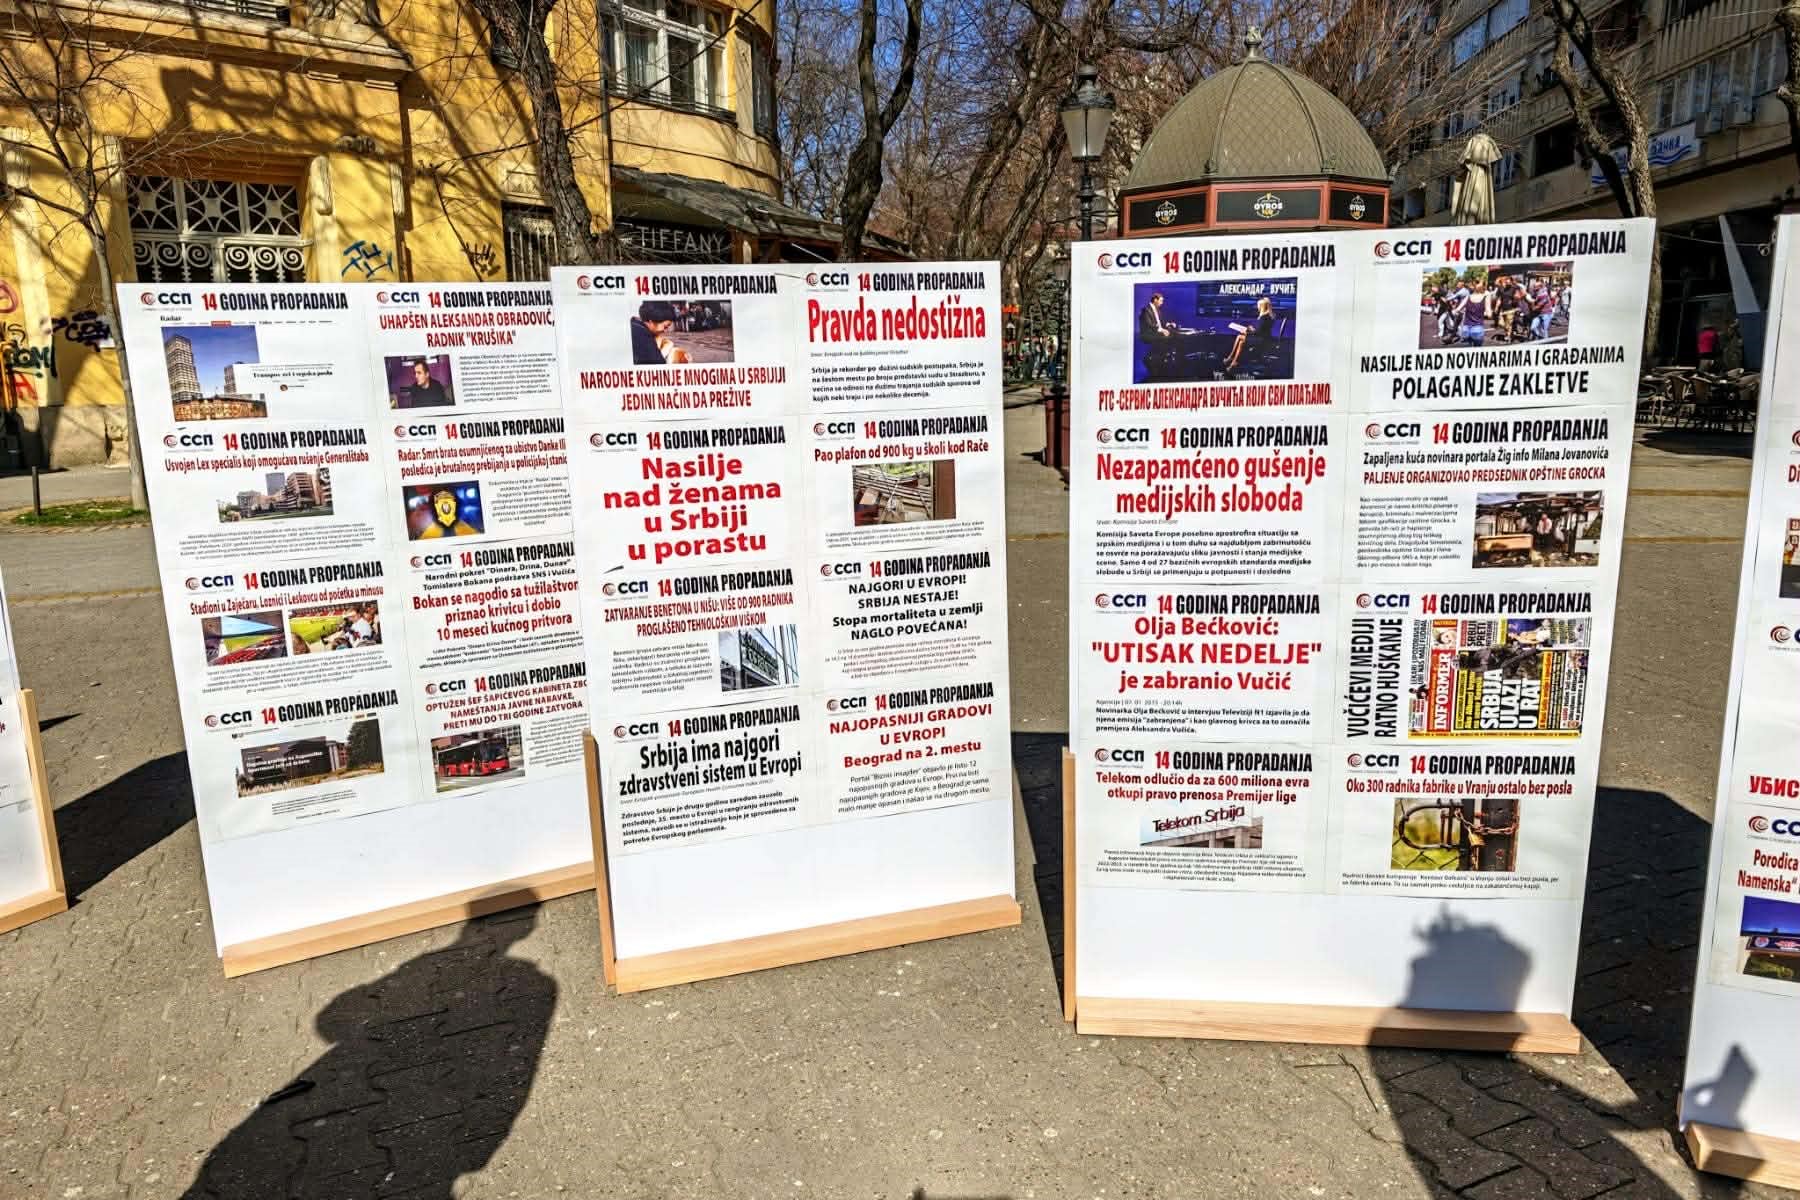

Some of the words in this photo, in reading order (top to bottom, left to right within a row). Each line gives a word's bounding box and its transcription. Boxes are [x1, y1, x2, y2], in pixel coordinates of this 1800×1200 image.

[636, 225, 725, 253] TIFFANY
[1164, 251, 1179, 273] 14
[1183, 249, 1237, 272] GODINA
[1242, 245, 1334, 269] PROPADANJA
[202, 293, 217, 310] 14
[220, 293, 268, 310] GODINA
[271, 292, 347, 309] PROPADANJA
[430, 312, 494, 327] ALEKSANDAR
[807, 296, 877, 342] Pravda
[426, 332, 465, 347] RADNIK
[1361, 354, 1411, 372] NASILJE
[1415, 353, 1443, 370] NAD
[1446, 350, 1531, 368] NOVINARIMA
[1535, 349, 1539, 365] I
[580, 371, 634, 388] NARODNE
[636, 369, 681, 386] KUHINJE
[684, 368, 735, 385] MNOGIMA
[738, 367, 745, 384] U
[1392, 374, 1495, 399] POLAGANJE
[1500, 371, 1589, 396] ZAKLETVE
[622, 393, 655, 410] JEDINI
[692, 391, 707, 408] DA
[1268, 385, 1285, 405] СВИ
[165, 458, 195, 473] Usvojen
[196, 458, 209, 470] Lex
[211, 455, 241, 471] specialis
[242, 455, 256, 470] koji
[815, 448, 833, 461] Pao
[835, 446, 866, 463] plafon
[868, 445, 880, 458] od
[882, 444, 900, 457] 900
[902, 443, 914, 459] kg
[916, 446, 921, 455] u
[947, 440, 965, 453] kod
[1364, 451, 1404, 467] Zapaljena
[1427, 450, 1463, 463] novinara
[1465, 449, 1495, 465] portala
[1512, 448, 1529, 461] info
[1531, 447, 1559, 460] Milana
[642, 453, 742, 481] Nasilje
[603, 484, 661, 509] nad
[1117, 484, 1215, 520] medijskih
[1221, 483, 1303, 512] sloboda
[644, 516, 662, 533] u
[671, 504, 747, 533] Srbiji
[628, 543, 646, 560] u
[654, 533, 766, 564] porastu
[849, 580, 903, 593] NAJGORI
[906, 579, 915, 588] U
[918, 574, 965, 587] EVROPI!
[858, 595, 900, 608] SRBIJA
[903, 590, 958, 604] NESTAJE!
[437, 627, 450, 640] 10
[452, 622, 488, 638] meseci
[531, 614, 572, 631] pritvora
[1135, 617, 1176, 639] Olja
[1182, 615, 1279, 635] Bećković:
[1351, 618, 1375, 666] MEDIJI
[1119, 670, 1138, 693] je
[1143, 671, 1233, 690] zabranio
[1435, 652, 1451, 729] INFORMER
[1480, 669, 1503, 729] SRBIJA
[1500, 679, 1521, 729] ULAZI
[1522, 679, 1540, 712] RAT
[830, 712, 924, 734] NAJOPASNIJI
[928, 704, 992, 721] GRADOVI
[1375, 695, 1397, 738] RATNO
[1520, 715, 1538, 729] U
[880, 735, 889, 745] U
[894, 727, 946, 744] EVROPI
[640, 744, 688, 771] Srbija
[692, 739, 721, 761] ima
[724, 728, 780, 762] najgori
[844, 749, 902, 768] Beograd
[906, 748, 922, 759] na
[926, 746, 938, 757] 2.
[941, 740, 982, 755] mestu
[620, 765, 700, 796] zdravstveni
[703, 763, 746, 785] sistem
[748, 763, 757, 776] u
[760, 751, 802, 777] Evropi
[1096, 771, 1141, 783] Telekom
[1187, 773, 1200, 784] da
[1203, 777, 1215, 785] za
[1218, 775, 1238, 785] 600
[1241, 775, 1282, 786] miliona
[1285, 778, 1309, 787] evra
[1107, 787, 1143, 800] otkupi
[1145, 790, 1176, 801] pravo
[1179, 791, 1223, 802] prenosa
[1226, 790, 1273, 804] Premijer
[1276, 791, 1296, 804] lige
[1346, 778, 1364, 792] Oko
[1367, 779, 1383, 792] 300
[1385, 779, 1420, 792] radnika
[1422, 779, 1455, 793] fabrike
[1457, 783, 1463, 793] u
[1465, 780, 1495, 796] Vranju
[1497, 780, 1526, 794] ostalo
[1528, 780, 1545, 794] bez
[1546, 780, 1572, 797] posla
[1152, 811, 1202, 833] Telekom
[1205, 805, 1245, 823] Srbija
[1753, 849, 1798, 871] Porodica
